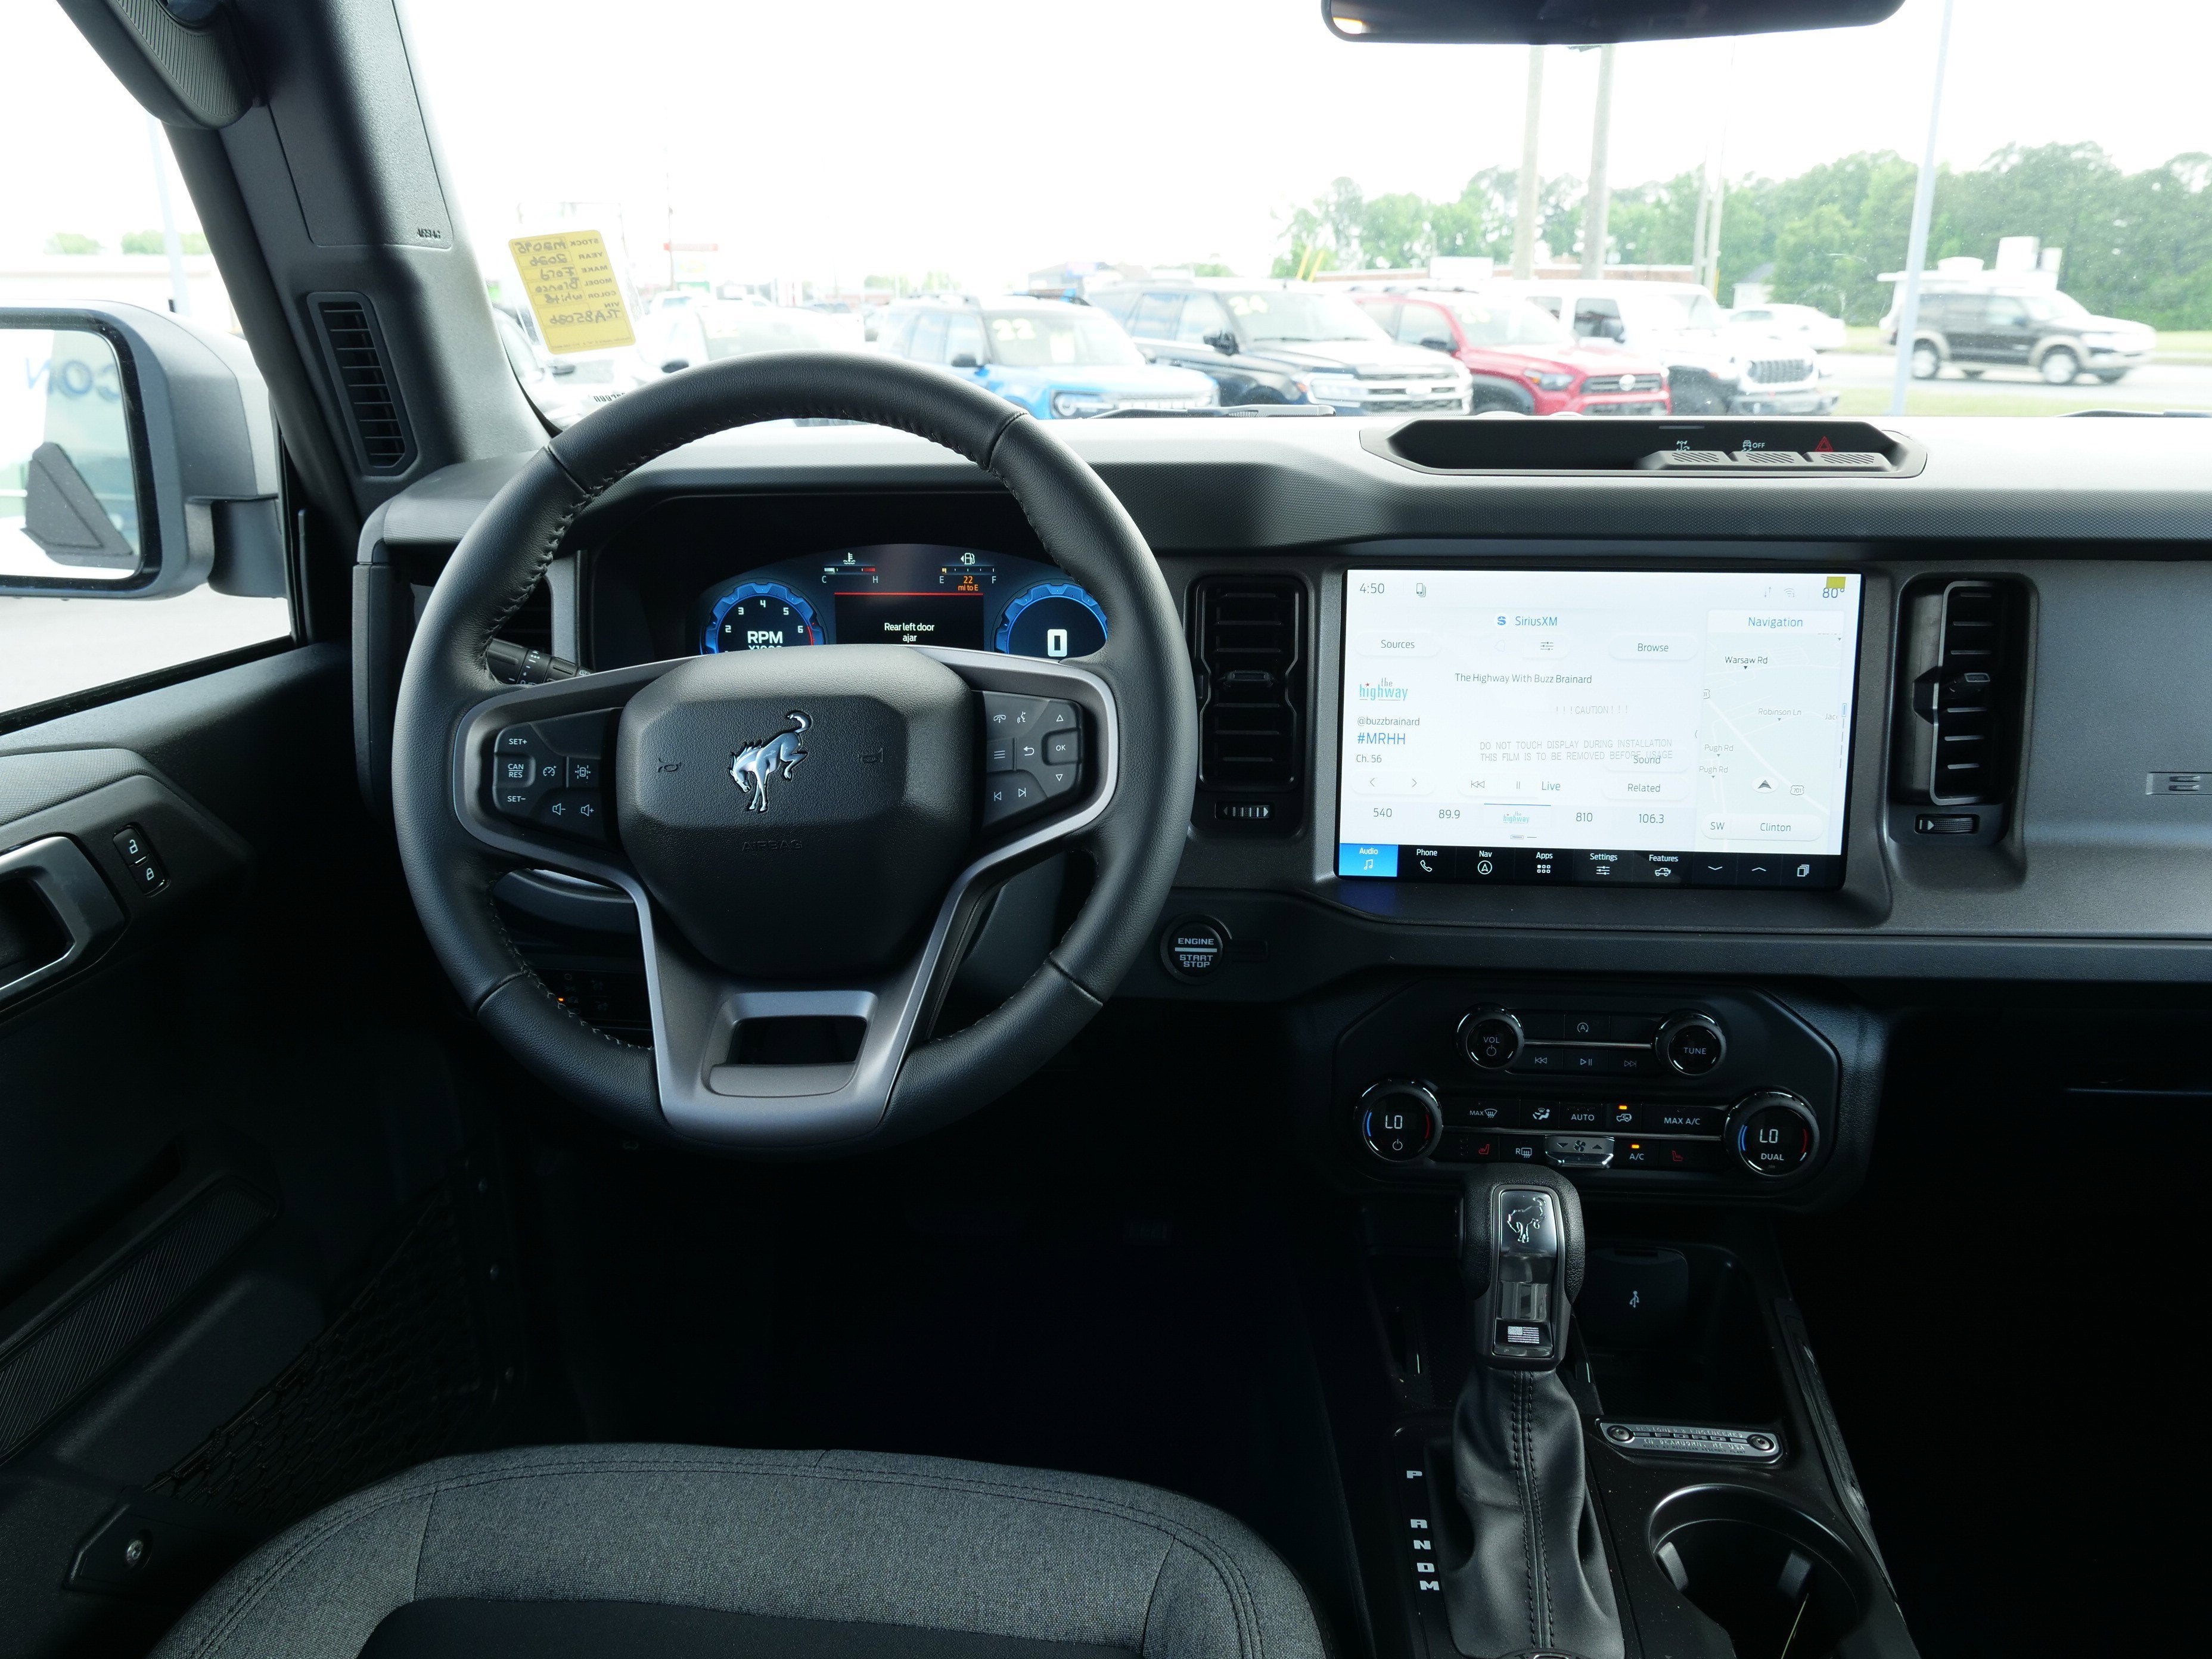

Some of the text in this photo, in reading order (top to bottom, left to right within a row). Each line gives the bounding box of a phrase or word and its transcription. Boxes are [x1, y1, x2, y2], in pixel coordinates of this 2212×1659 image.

[1359, 582, 1385, 594] 4:50
[759, 599, 766, 608] 4
[1515, 616, 1558, 627] SiriusXM
[1748, 617, 1804, 628] Navigation
[884, 623, 934, 631] Rear left door
[747, 630, 783, 644] RPM
[902, 634, 917, 644] ajar
[1048, 629, 1067, 657] 0
[1381, 639, 1415, 650] Sources
[1638, 643, 1669, 653] Browse
[1725, 656, 1768, 664] Warsaw Rd
[1381, 678, 1393, 687] the
[1455, 673, 1592, 684] The Highway With Buzz Brainard
[1359, 684, 1408, 701] highway
[1758, 708, 1802, 716] Robinson Ln
[1357, 716, 1420, 727] @buzzbrainard
[1357, 732, 1406, 745] #MRHH
[1480, 739, 1673, 750] DO NOT TOUCH DISPLAY DURING INSTALLATION
[1704, 744, 1733, 753] Pugh Rd
[1356, 754, 1382, 763] Ch. 56
[1481, 753, 1498, 762] THIS
[1503, 753, 1520, 762] FILM
[1524, 753, 1533, 761] IS
[1536, 752, 1548, 761] TO
[1551, 752, 1562, 761] BE
[1567, 751, 1605, 760] REMOVED
[1633, 754, 1661, 765] Sound
[1699, 766, 1717, 775] Pugh
[1542, 781, 1561, 791] Live
[1627, 784, 1661, 793] Related
[1373, 808, 1392, 818] 540
[1439, 809, 1461, 819] 89.9
[1576, 812, 1593, 822] 810
[1503, 814, 1530, 824] highway
[1638, 814, 1664, 824] 106.3
[1710, 822, 1725, 831] SW
[1760, 822, 1791, 832] Clinton
[1416, 849, 1438, 857] Phone
[1536, 852, 1553, 860] Apps
[1590, 853, 1618, 862] Settings
[1686, 1117, 1701, 1126] A/C
[1629, 1152, 1645, 1161] A/C
[1406, 1470, 1422, 1478] P
[1413, 1540, 1431, 1549] N
[1416, 1562, 1435, 1573] D
[1419, 1580, 1440, 1590] M
